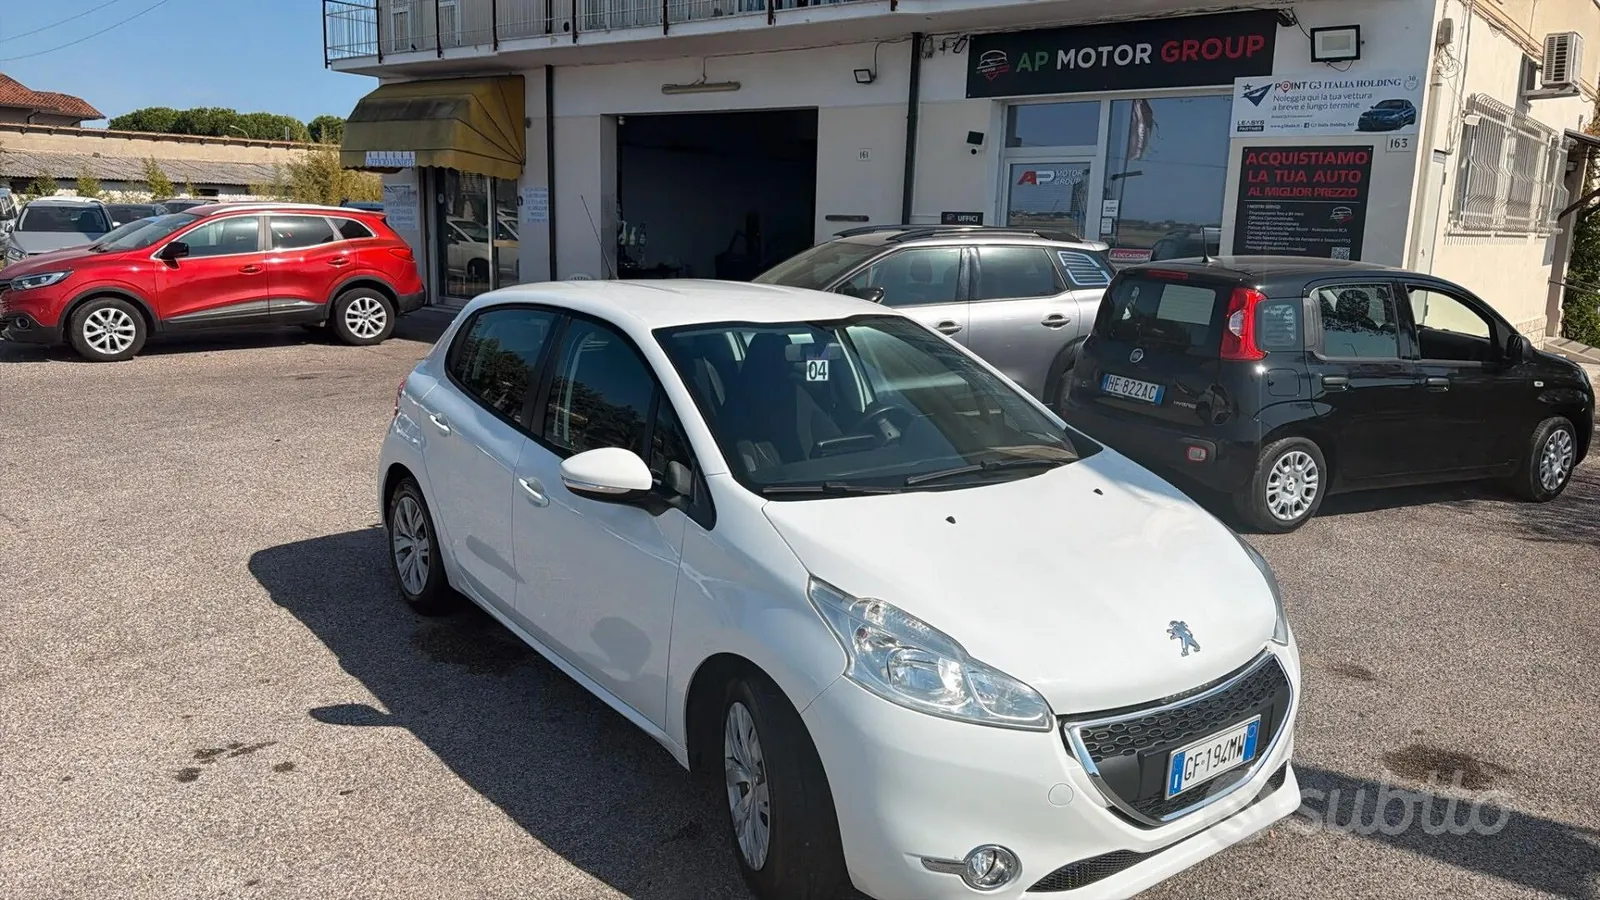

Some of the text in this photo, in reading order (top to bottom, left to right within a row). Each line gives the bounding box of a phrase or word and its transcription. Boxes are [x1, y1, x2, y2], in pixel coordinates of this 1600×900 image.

[1016, 35, 1265, 73] AP MOTOR GROUP
[1309, 81, 1322, 90] G3
[1324, 80, 1355, 89] ITALIA
[1356, 78, 1402, 88] HOLDING
[1273, 94, 1306, 103] Noleggia
[1343, 92, 1373, 100] vettura
[1306, 103, 1328, 112] lungo
[1330, 102, 1361, 110] termine
[1390, 138, 1408, 148] 163
[1246, 152, 1368, 166] ACQUISTIAMO
[1016, 170, 1055, 186] AP
[1248, 170, 1362, 183] LA TUA AUTO
[1248, 188, 1358, 198] AL MIGLIOR PREZZO
[809, 361, 827, 380] 04
